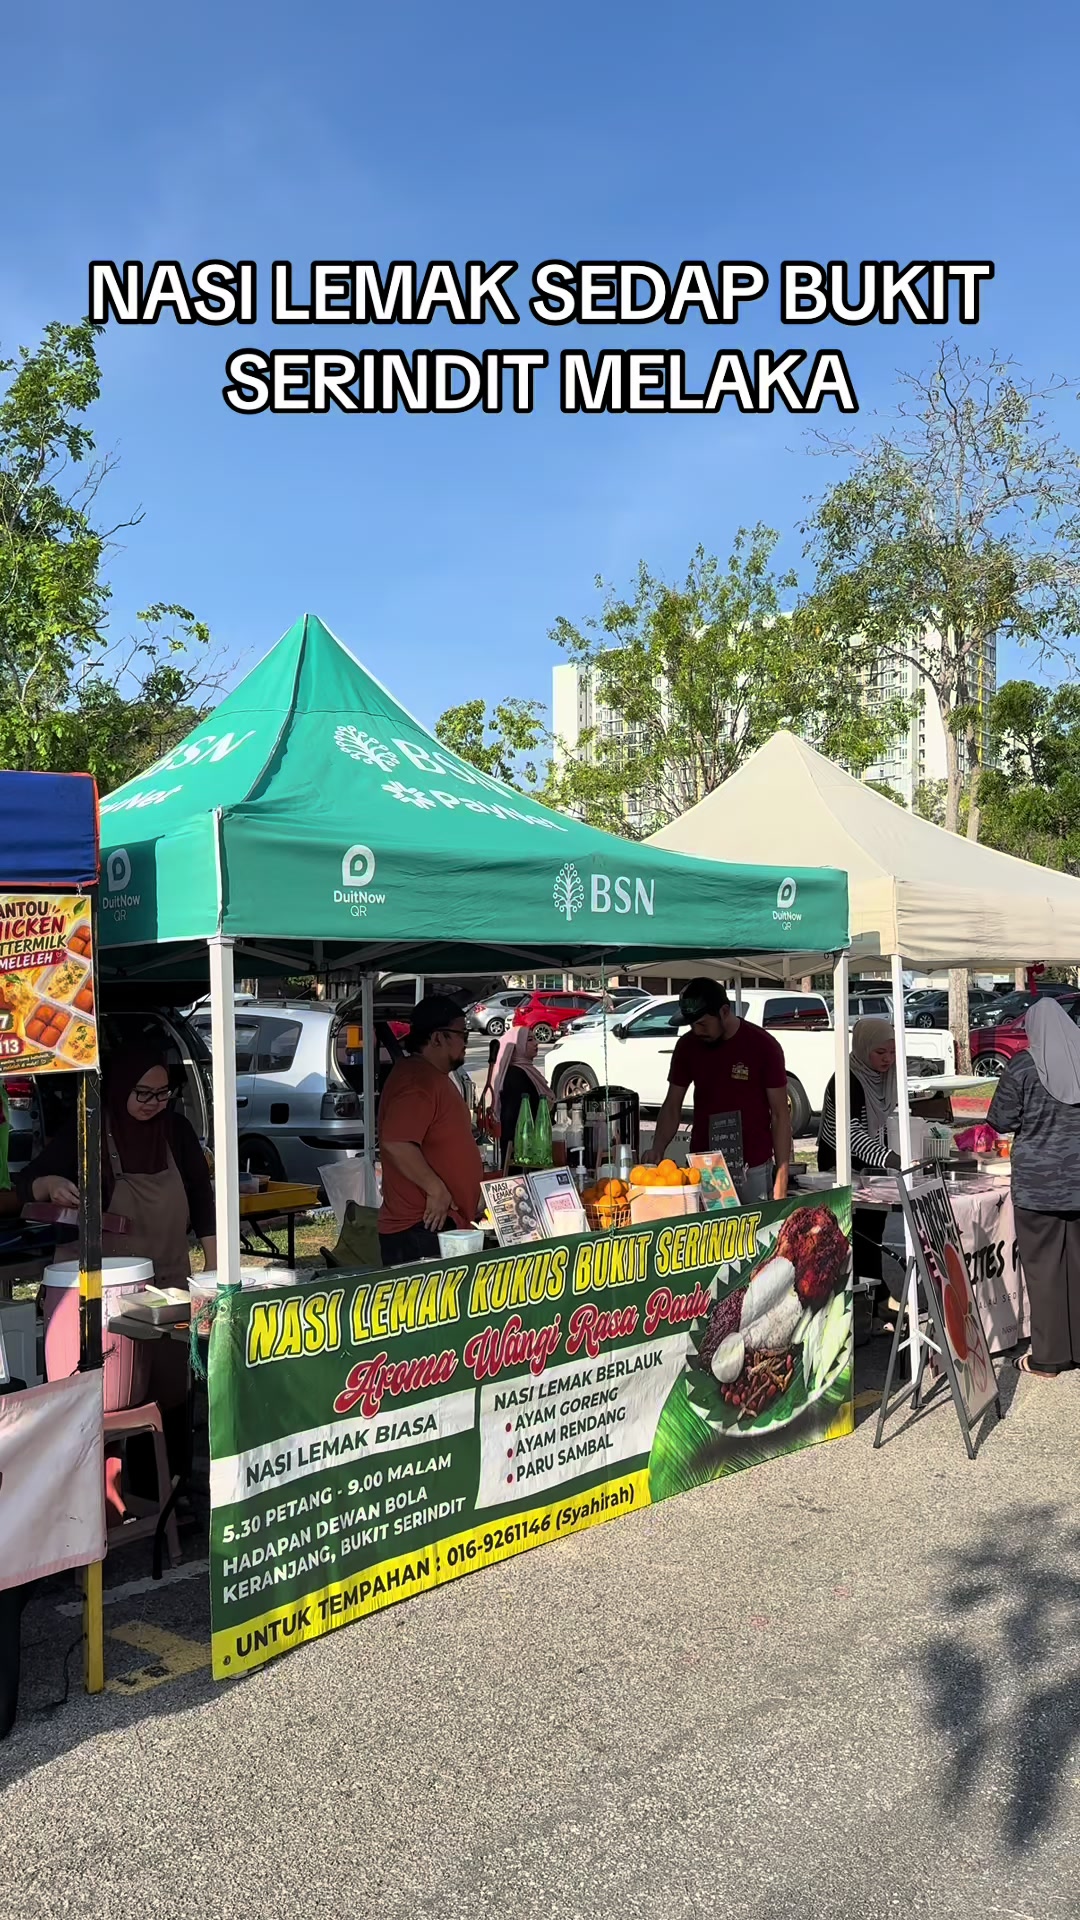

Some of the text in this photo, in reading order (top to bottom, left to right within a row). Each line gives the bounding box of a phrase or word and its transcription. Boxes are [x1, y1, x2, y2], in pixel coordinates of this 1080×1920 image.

[391, 738, 513, 800] BSN
[429, 789, 569, 832] PayNet
[102, 894, 141, 910] DuitNow
[113, 909, 127, 922] QR
[333, 890, 386, 904] DuitNow
[350, 905, 367, 917] QR
[590, 873, 655, 915] BSN
[772, 910, 802, 921] DuitNow
[0, 1038, 19, 1055] 13
[491, 1182, 508, 1193] NASI
[492, 1188, 514, 1202] LEMAK
[247, 1212, 762, 1368] NASI LEMAK KUKUS BUKIT SERINDIT
[333, 1282, 712, 1419] Aroma Wangi Rasa Padu
[494, 1350, 663, 1411] NASI LEMAK BERLAUK
[515, 1387, 619, 1431] AYAM GORENG
[516, 1407, 626, 1457] AYAM RENDANG
[246, 1413, 437, 1487] NASI LEMAK BIASA
[516, 1434, 614, 1482] PARU SAMBAL
[222, 1515, 261, 1543] 5.30
[265, 1487, 333, 1527] PETANG
[347, 1470, 383, 1496] 9.00
[388, 1453, 451, 1483] MALAM
[222, 1486, 428, 1576] HADAPAN DEWAN BOLA
[222, 1496, 466, 1603] KERANJANG, BUKIT SERINDIT
[235, 1605, 311, 1657] UNTUK
[318, 1557, 430, 1622] TEMPAHAN
[446, 1515, 551, 1567] 016-9261146
[555, 1483, 635, 1533] (Syahirah)
